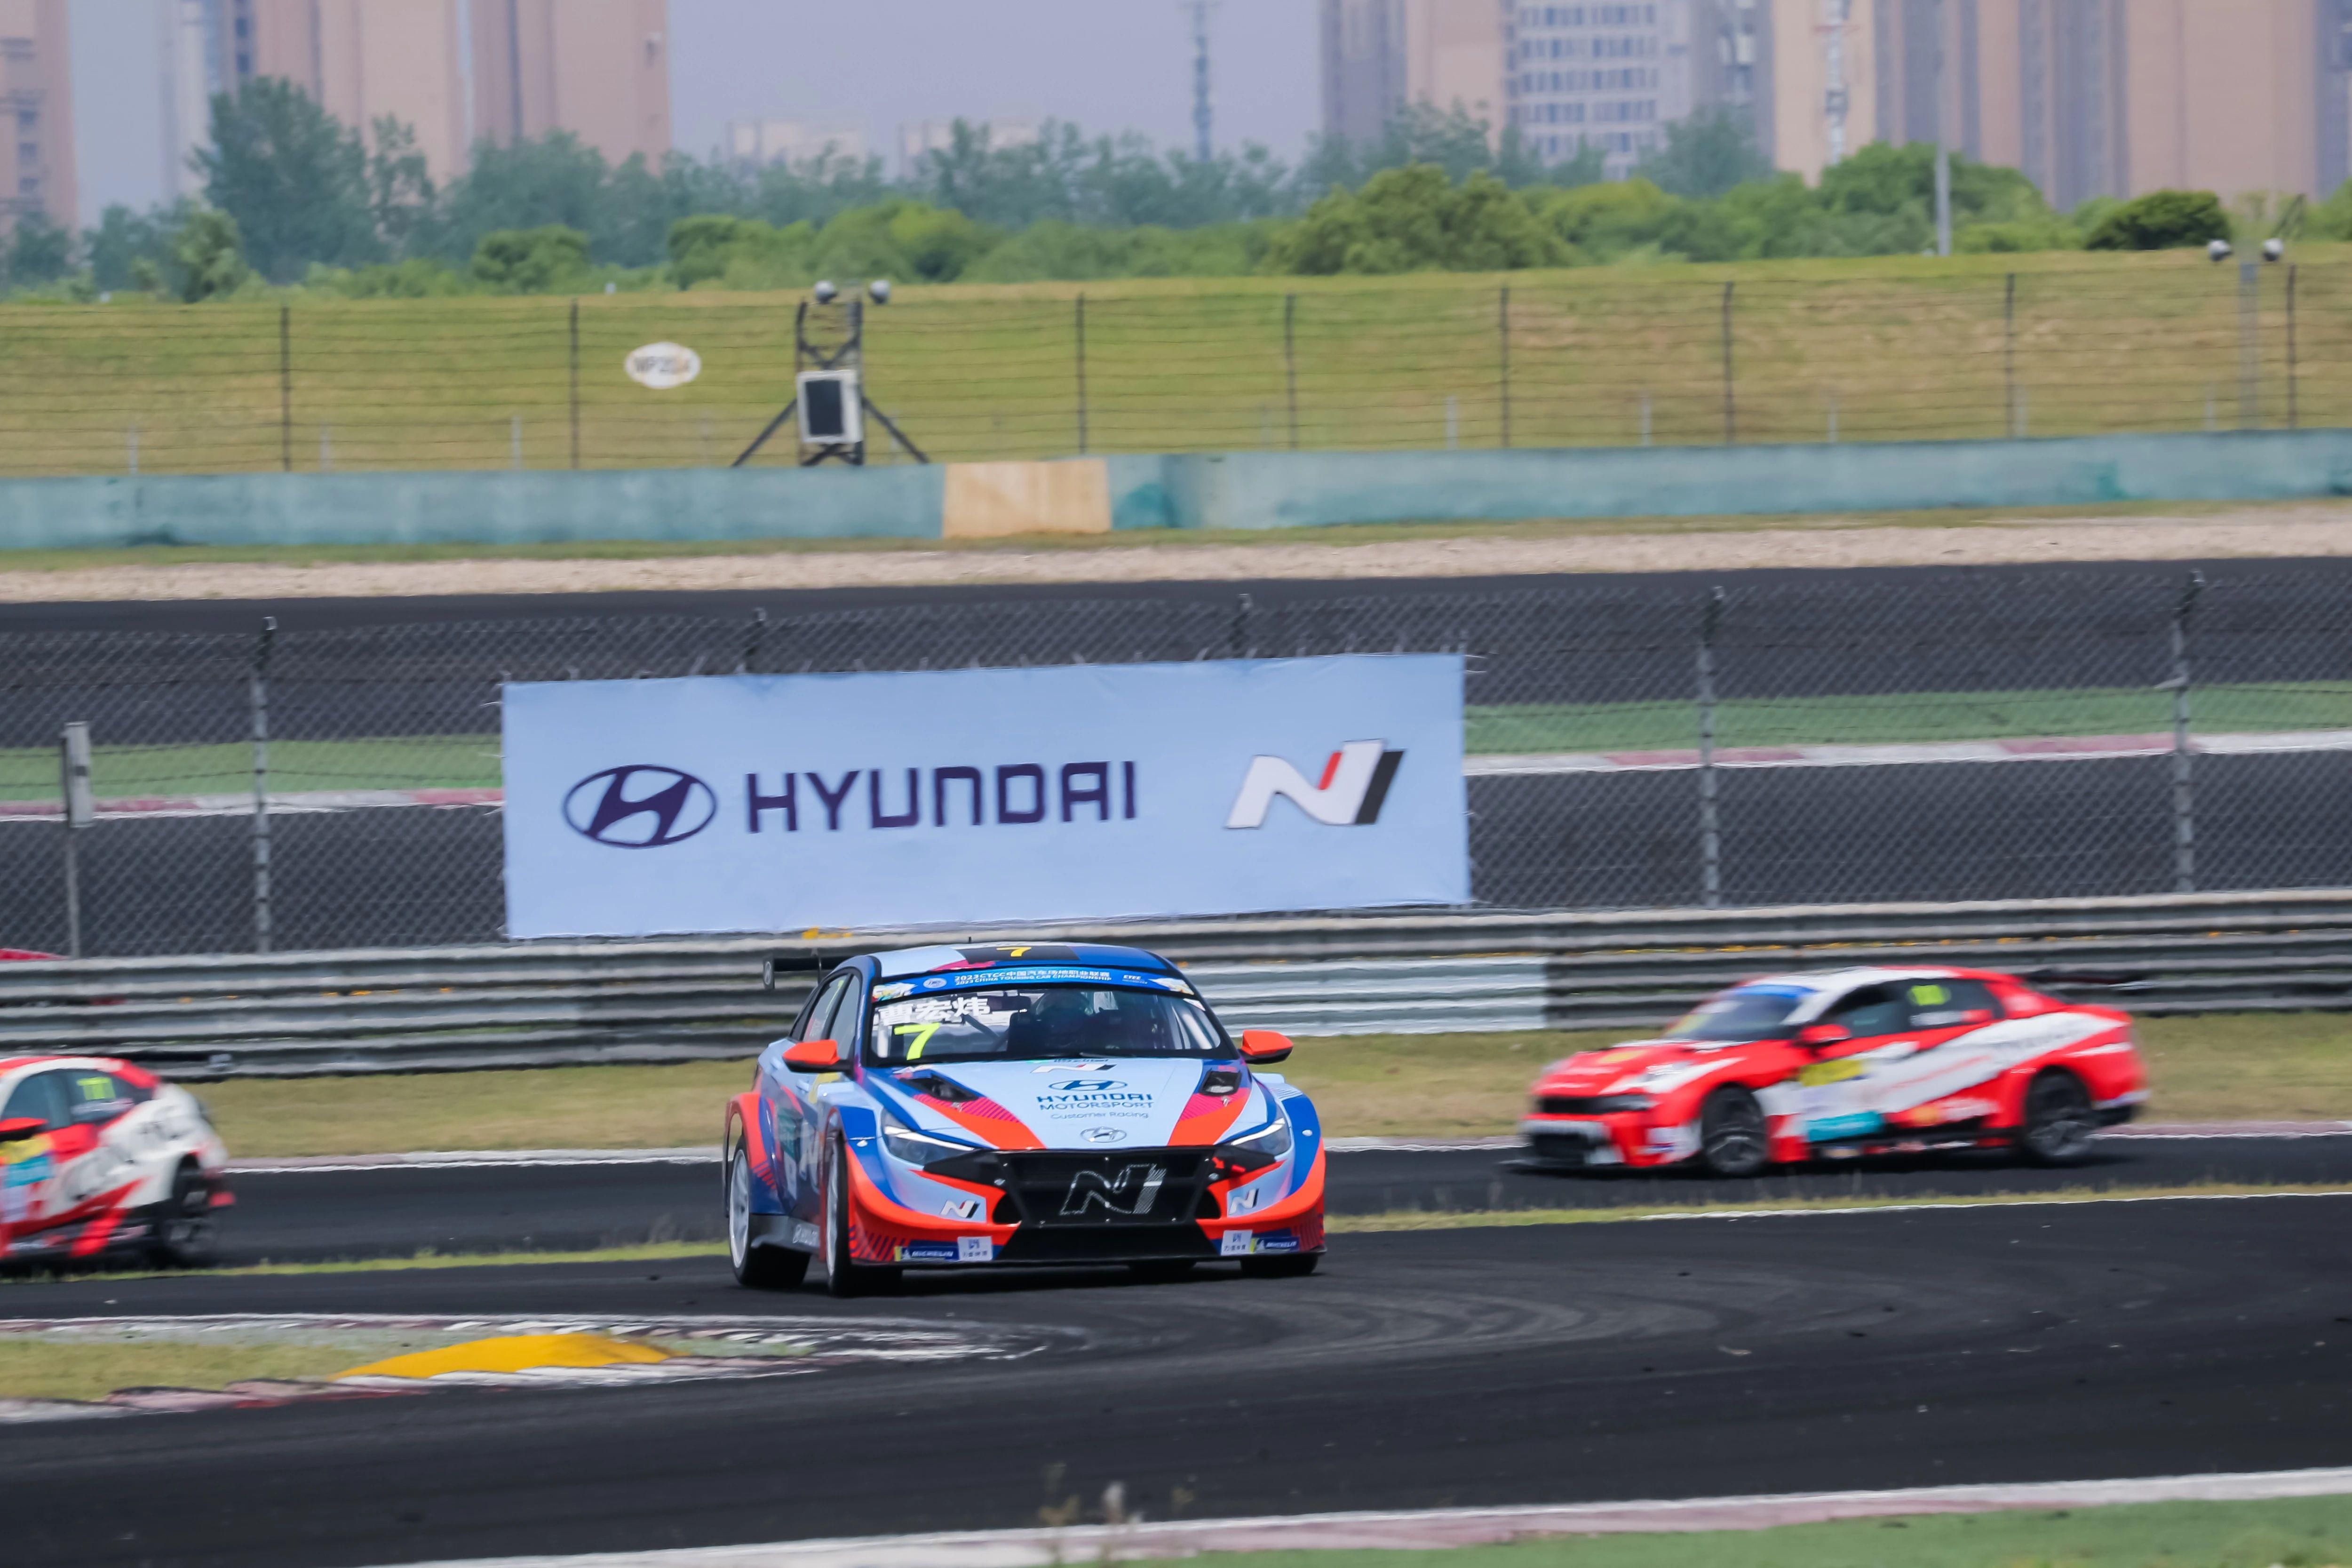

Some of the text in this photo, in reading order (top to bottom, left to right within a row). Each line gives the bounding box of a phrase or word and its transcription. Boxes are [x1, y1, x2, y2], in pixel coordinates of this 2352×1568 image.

[746, 760, 1136, 834] HYUNDAI
[996, 947, 1032, 957] 7
[894, 1022, 940, 1060] 7
[1036, 1093, 1153, 1102] HYUNDAI
[1040, 1102, 1154, 1111] MOTORSPORT
